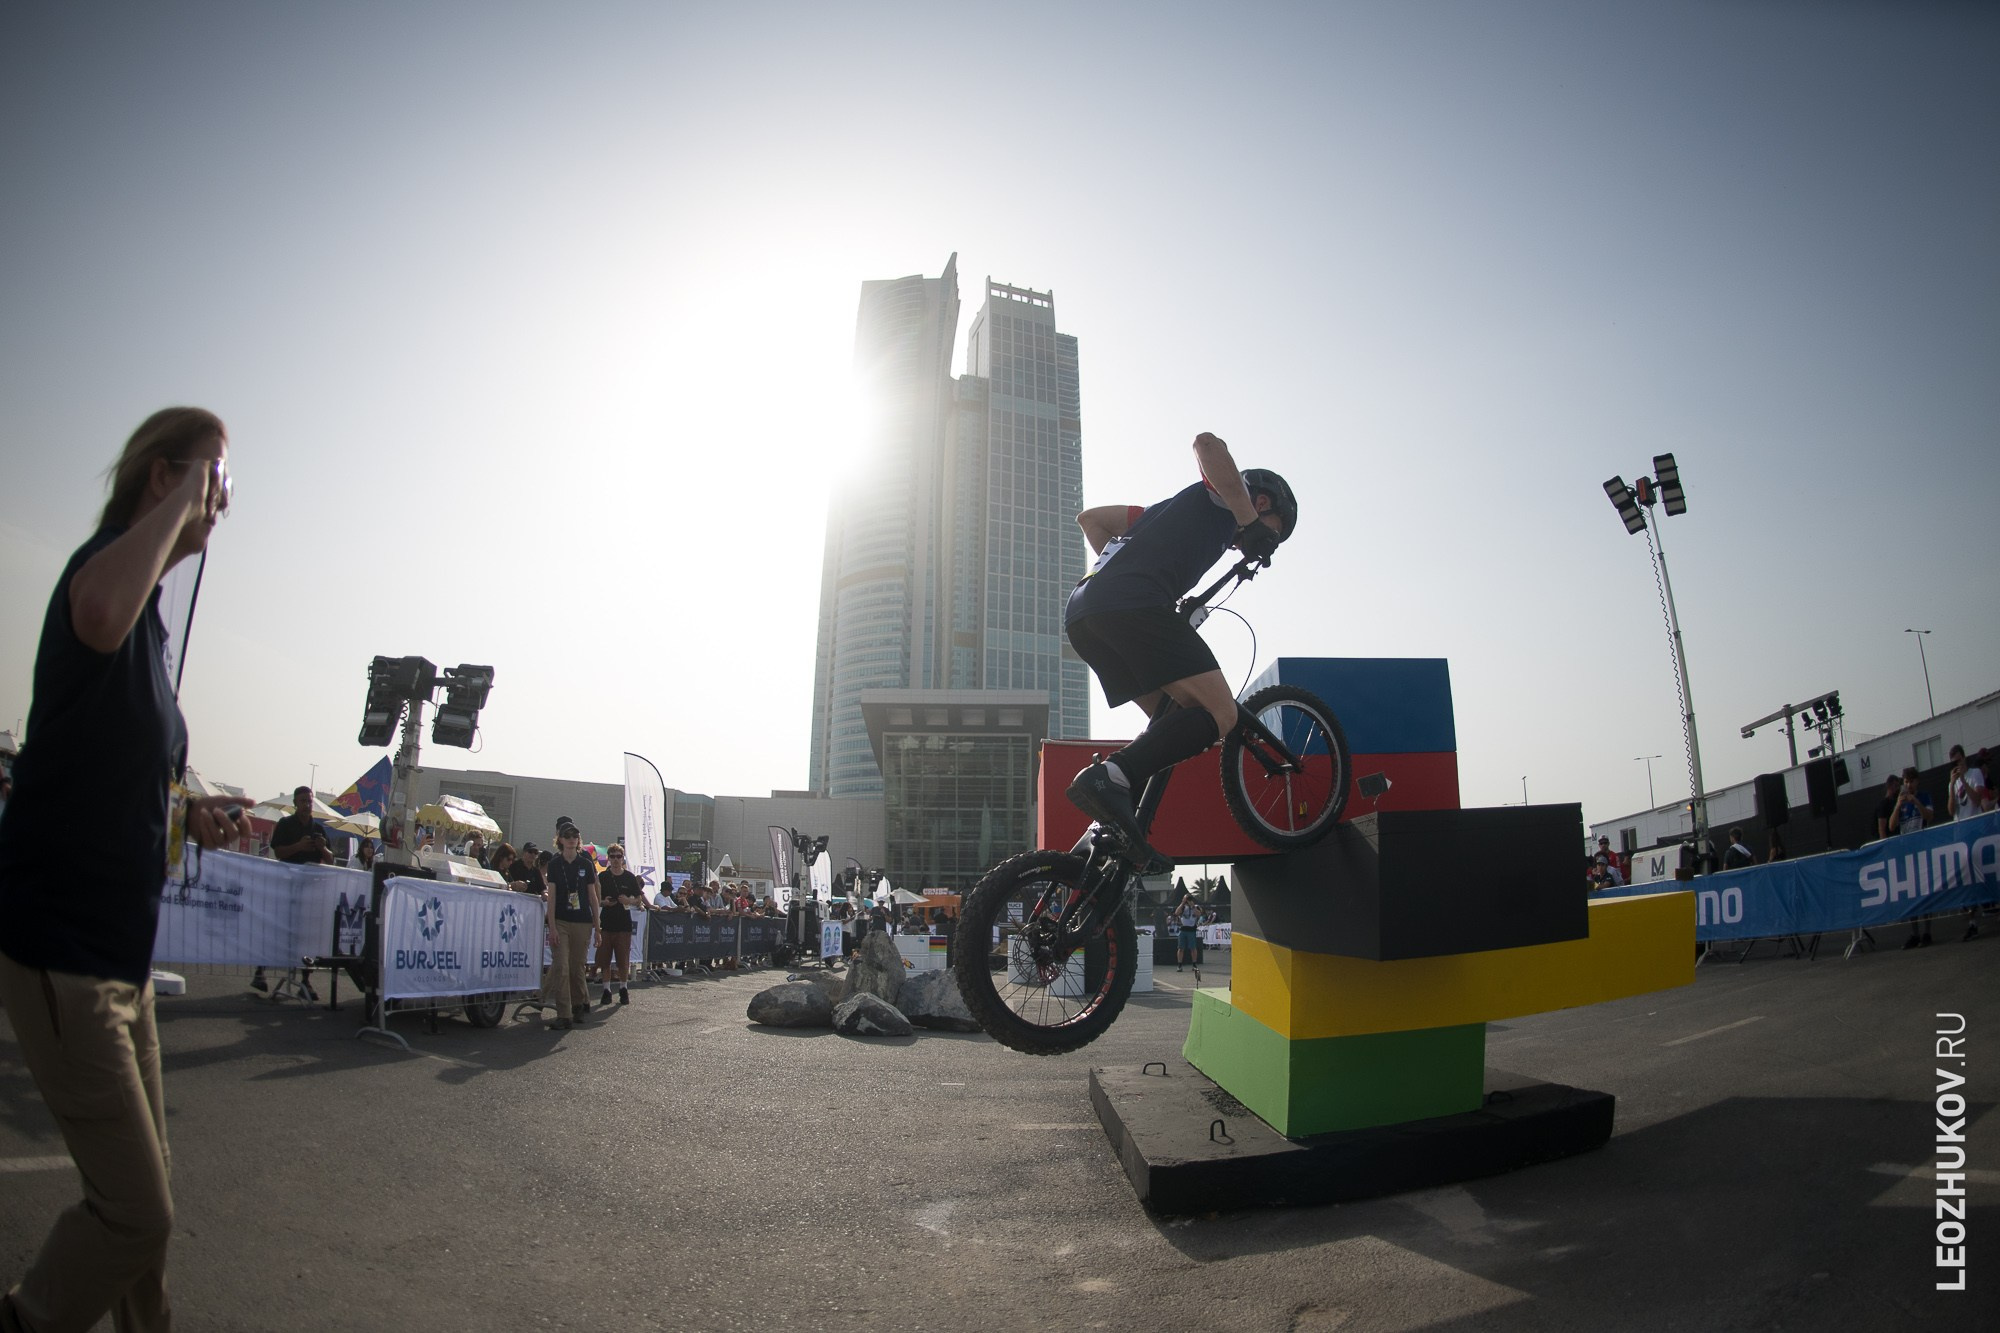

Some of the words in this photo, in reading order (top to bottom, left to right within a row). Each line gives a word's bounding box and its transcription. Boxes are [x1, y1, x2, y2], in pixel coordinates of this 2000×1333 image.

[1859, 834, 2000, 908] SHIMA
[219, 900, 244, 912] Rental
[396, 950, 461, 970] BURJEEL
[481, 951, 530, 968] BURJEEL
